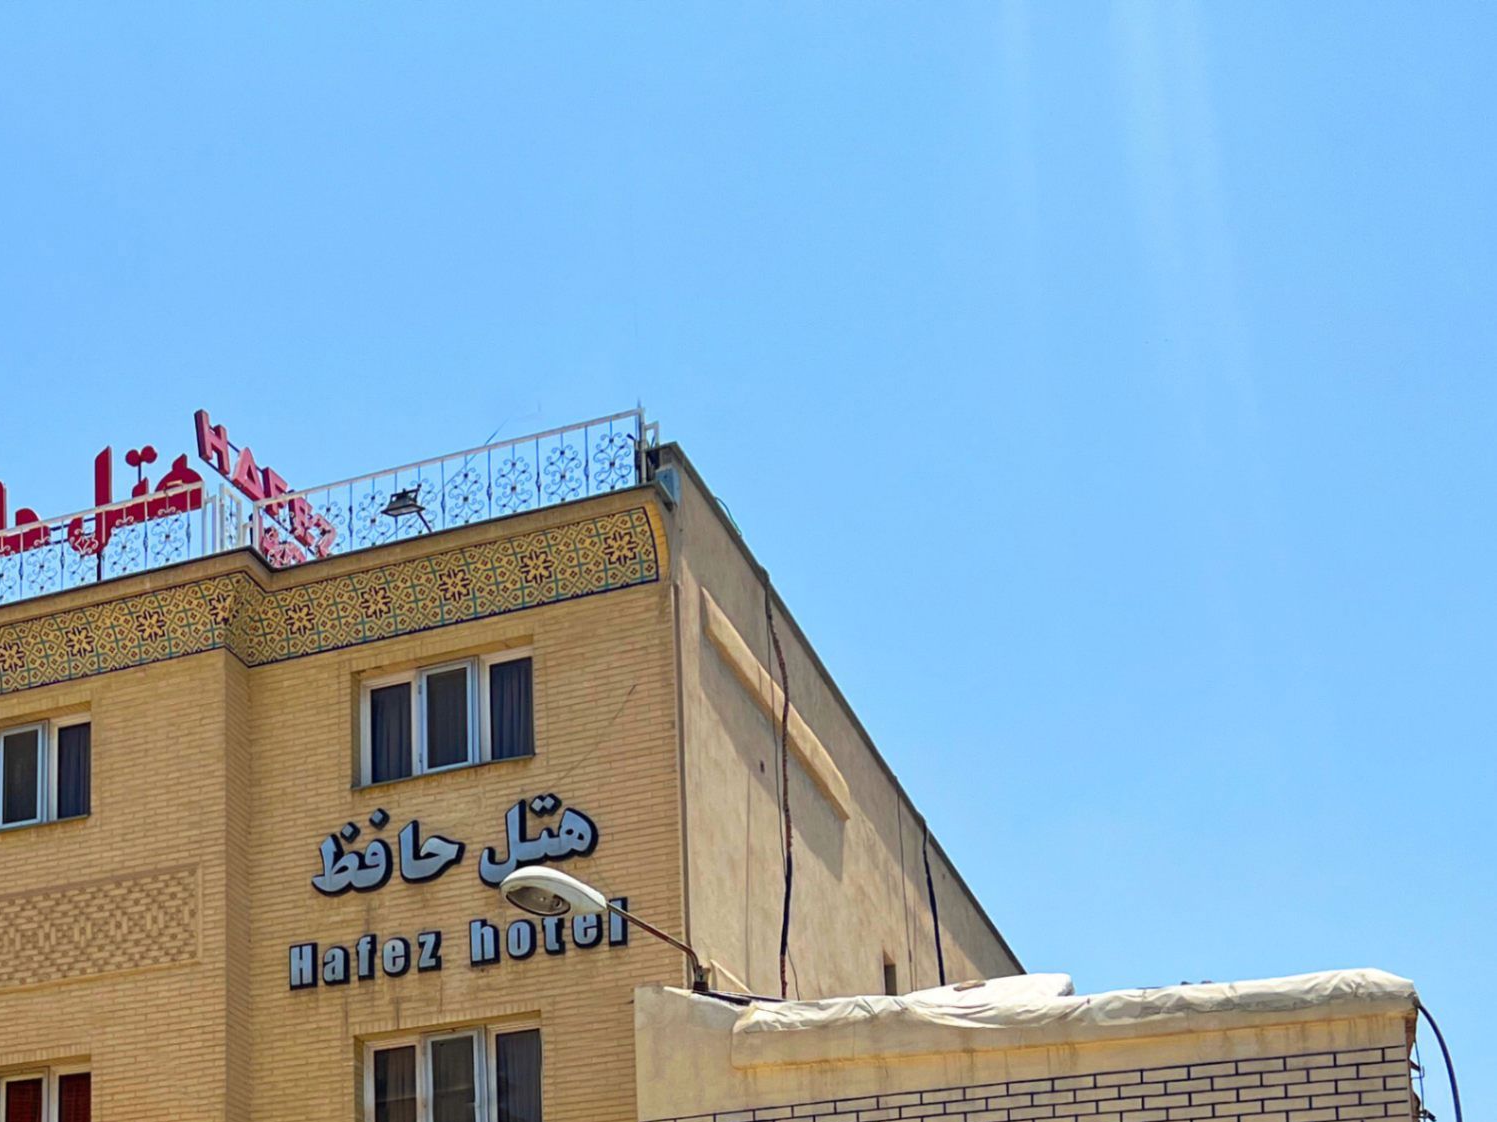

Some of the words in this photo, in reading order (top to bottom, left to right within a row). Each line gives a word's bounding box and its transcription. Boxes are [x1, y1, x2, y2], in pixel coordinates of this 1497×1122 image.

[68, 445, 203, 555] هتل
[311, 808, 466, 897] حافظ
[479, 792, 598, 888] هتل
[289, 930, 443, 990] Hafez
[469, 897, 629, 968] hotel
